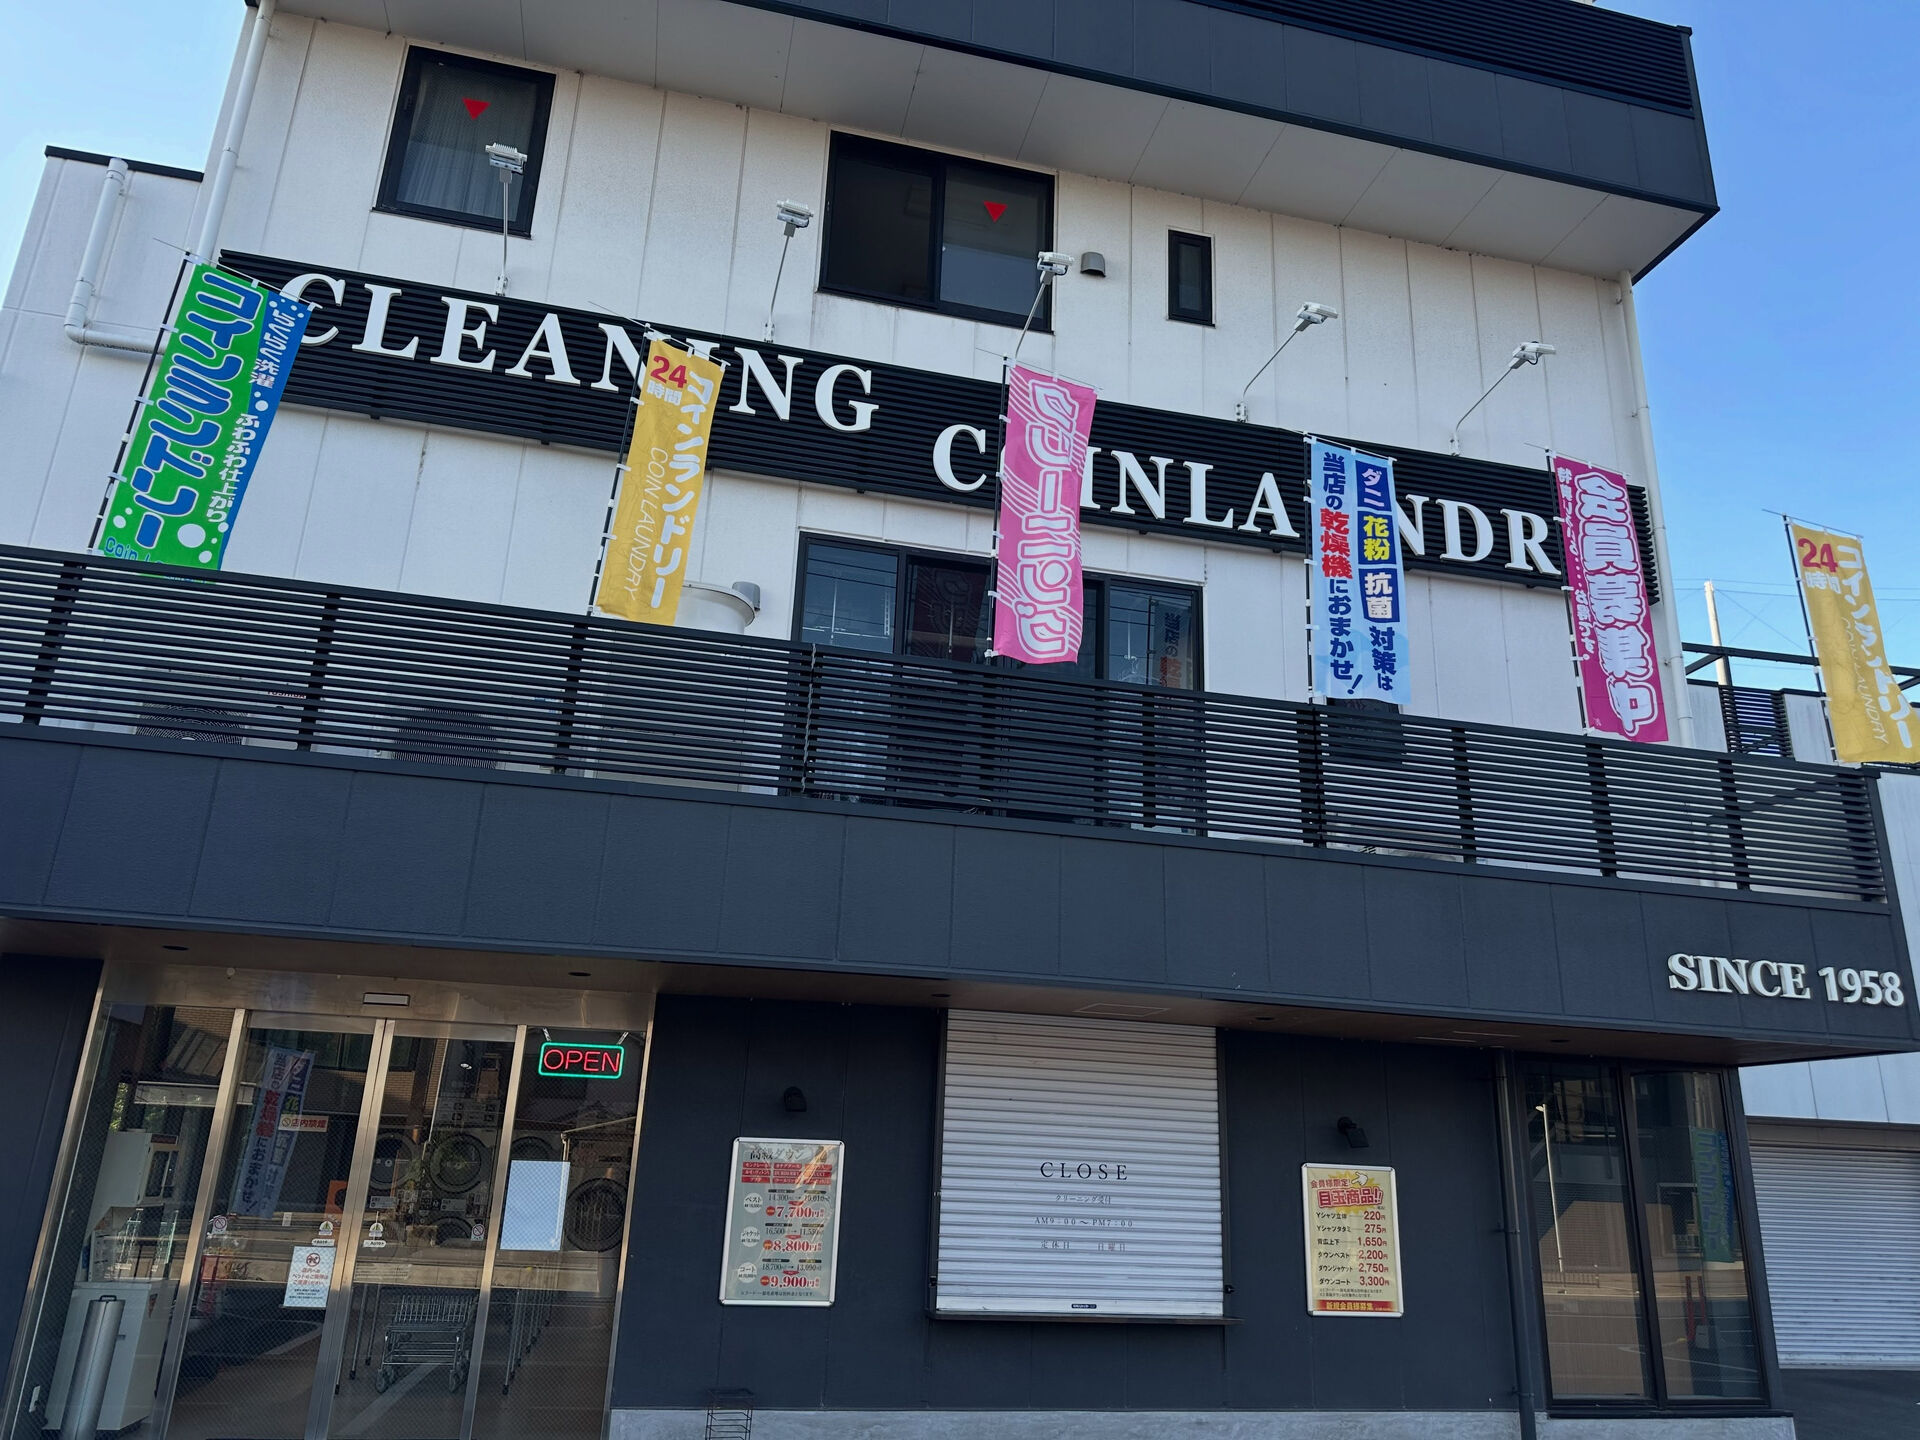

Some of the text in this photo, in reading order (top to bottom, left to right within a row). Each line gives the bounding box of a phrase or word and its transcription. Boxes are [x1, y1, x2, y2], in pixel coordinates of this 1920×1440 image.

[279, 273, 880, 433] CLEANNG
[646, 381, 682, 406] 時間
[650, 355, 687, 388] 24
[131, 272, 262, 549] コインランドリー
[206, 413, 259, 523] ふわふわ仕上がり
[651, 371, 714, 608] コインランドリー
[623, 447, 668, 601] COIN LAUNDRY
[1798, 538, 1838, 573] 24
[1361, 469, 1397, 692] ダニ 花粉 抗菌 対策は
[1667, 952, 1905, 1006] SINCE 1958
[543, 1048, 621, 1073] OPEN
[1040, 1161, 1127, 1180] CLOSE
